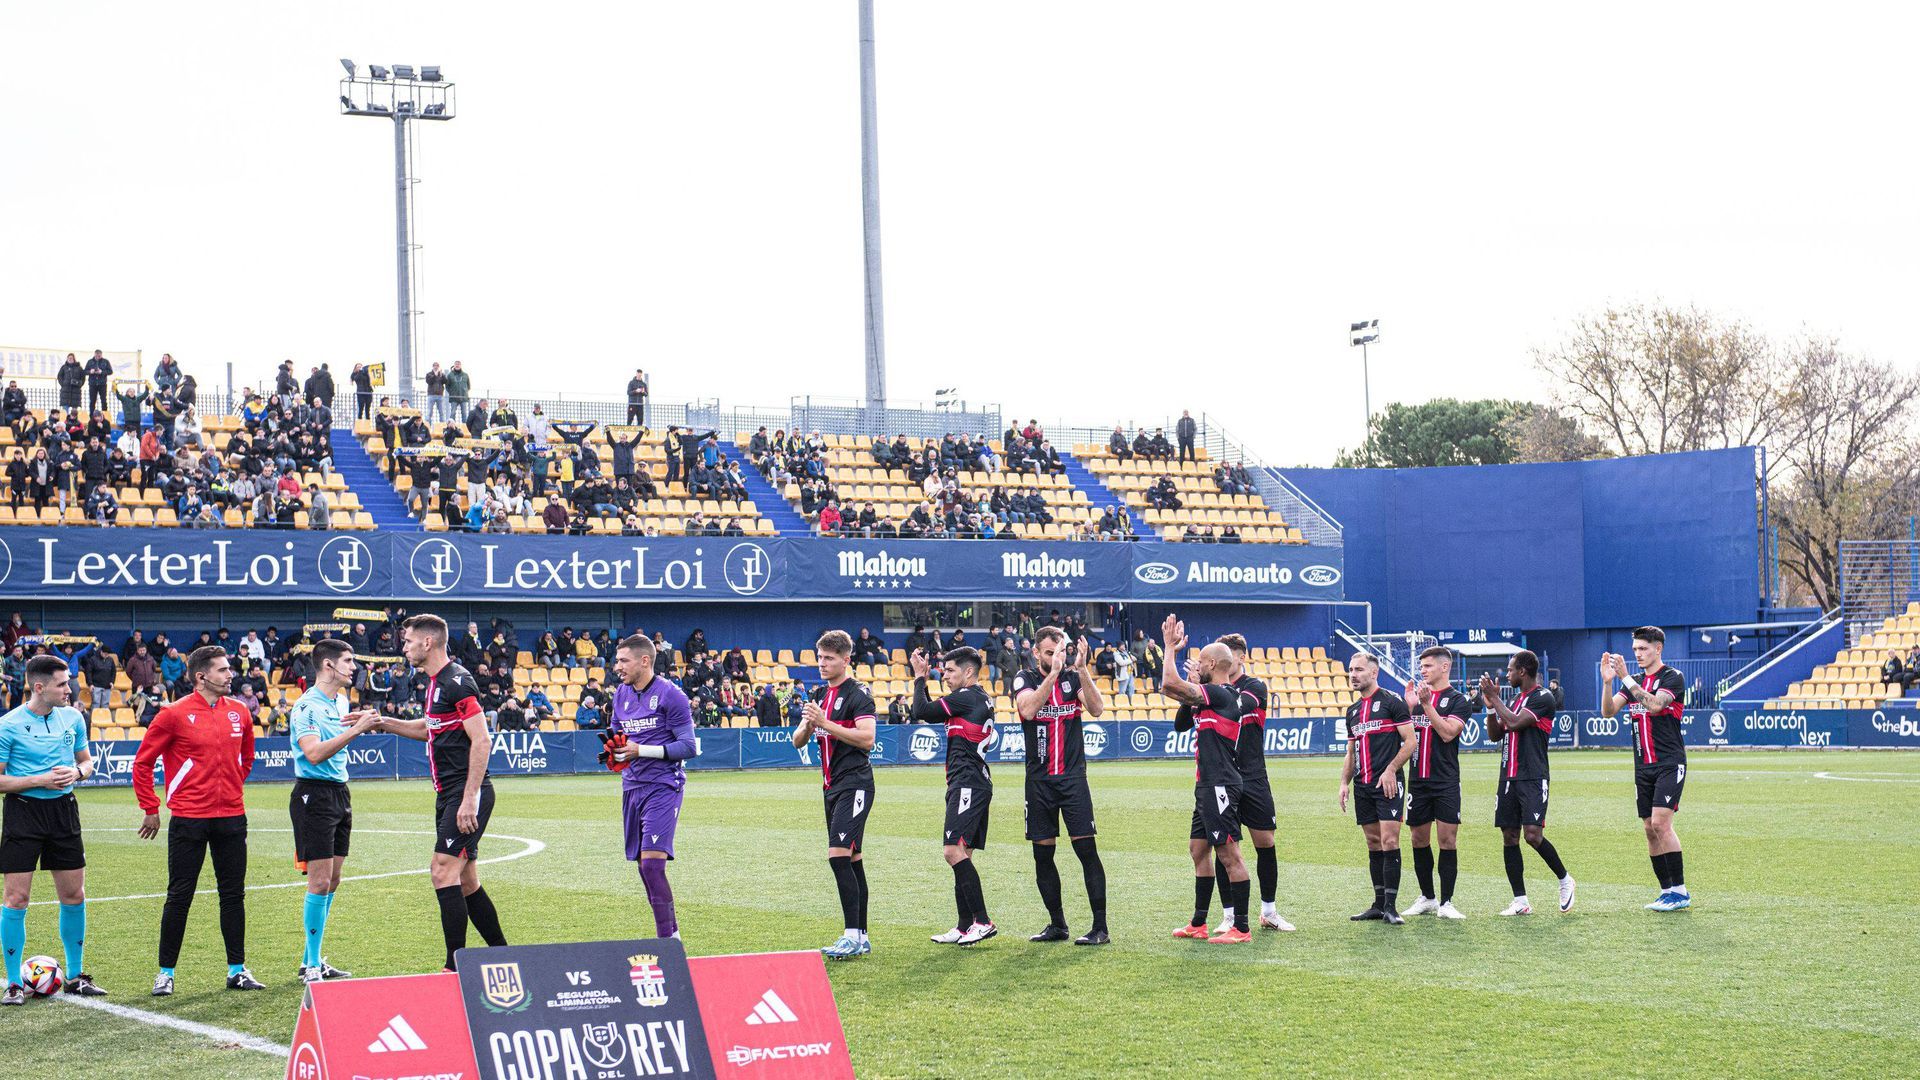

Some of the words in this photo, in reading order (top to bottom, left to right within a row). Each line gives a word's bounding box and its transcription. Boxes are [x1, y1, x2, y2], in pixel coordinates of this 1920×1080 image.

[372, 369, 381, 379] 15
[38, 538, 298, 586] LexterLoi
[482, 544, 707, 589] LexterLoi
[837, 550, 927, 577] Mahou
[1001, 551, 1086, 577] Mahou
[1144, 567, 1169, 580] Ford
[1187, 561, 1292, 584] Almoauto
[1308, 569, 1332, 583] Ford
[1468, 629, 1487, 642] BAR
[1041, 704, 1075, 714] alasur
[1744, 710, 1806, 730] alcorcón
[254, 751, 270, 759] AJA
[271, 751, 294, 759] RURA
[507, 754, 547, 772] Viajes
[565, 970, 592, 986] VS
[546, 996, 622, 1008] ELIMINATORIA
[556, 989, 609, 1000] SEGUNDA
[489, 1027, 588, 1080] COPA
[625, 1020, 690, 1077] REY
[751, 1042, 832, 1061] FACTORY
[598, 1069, 626, 1079] DEL
